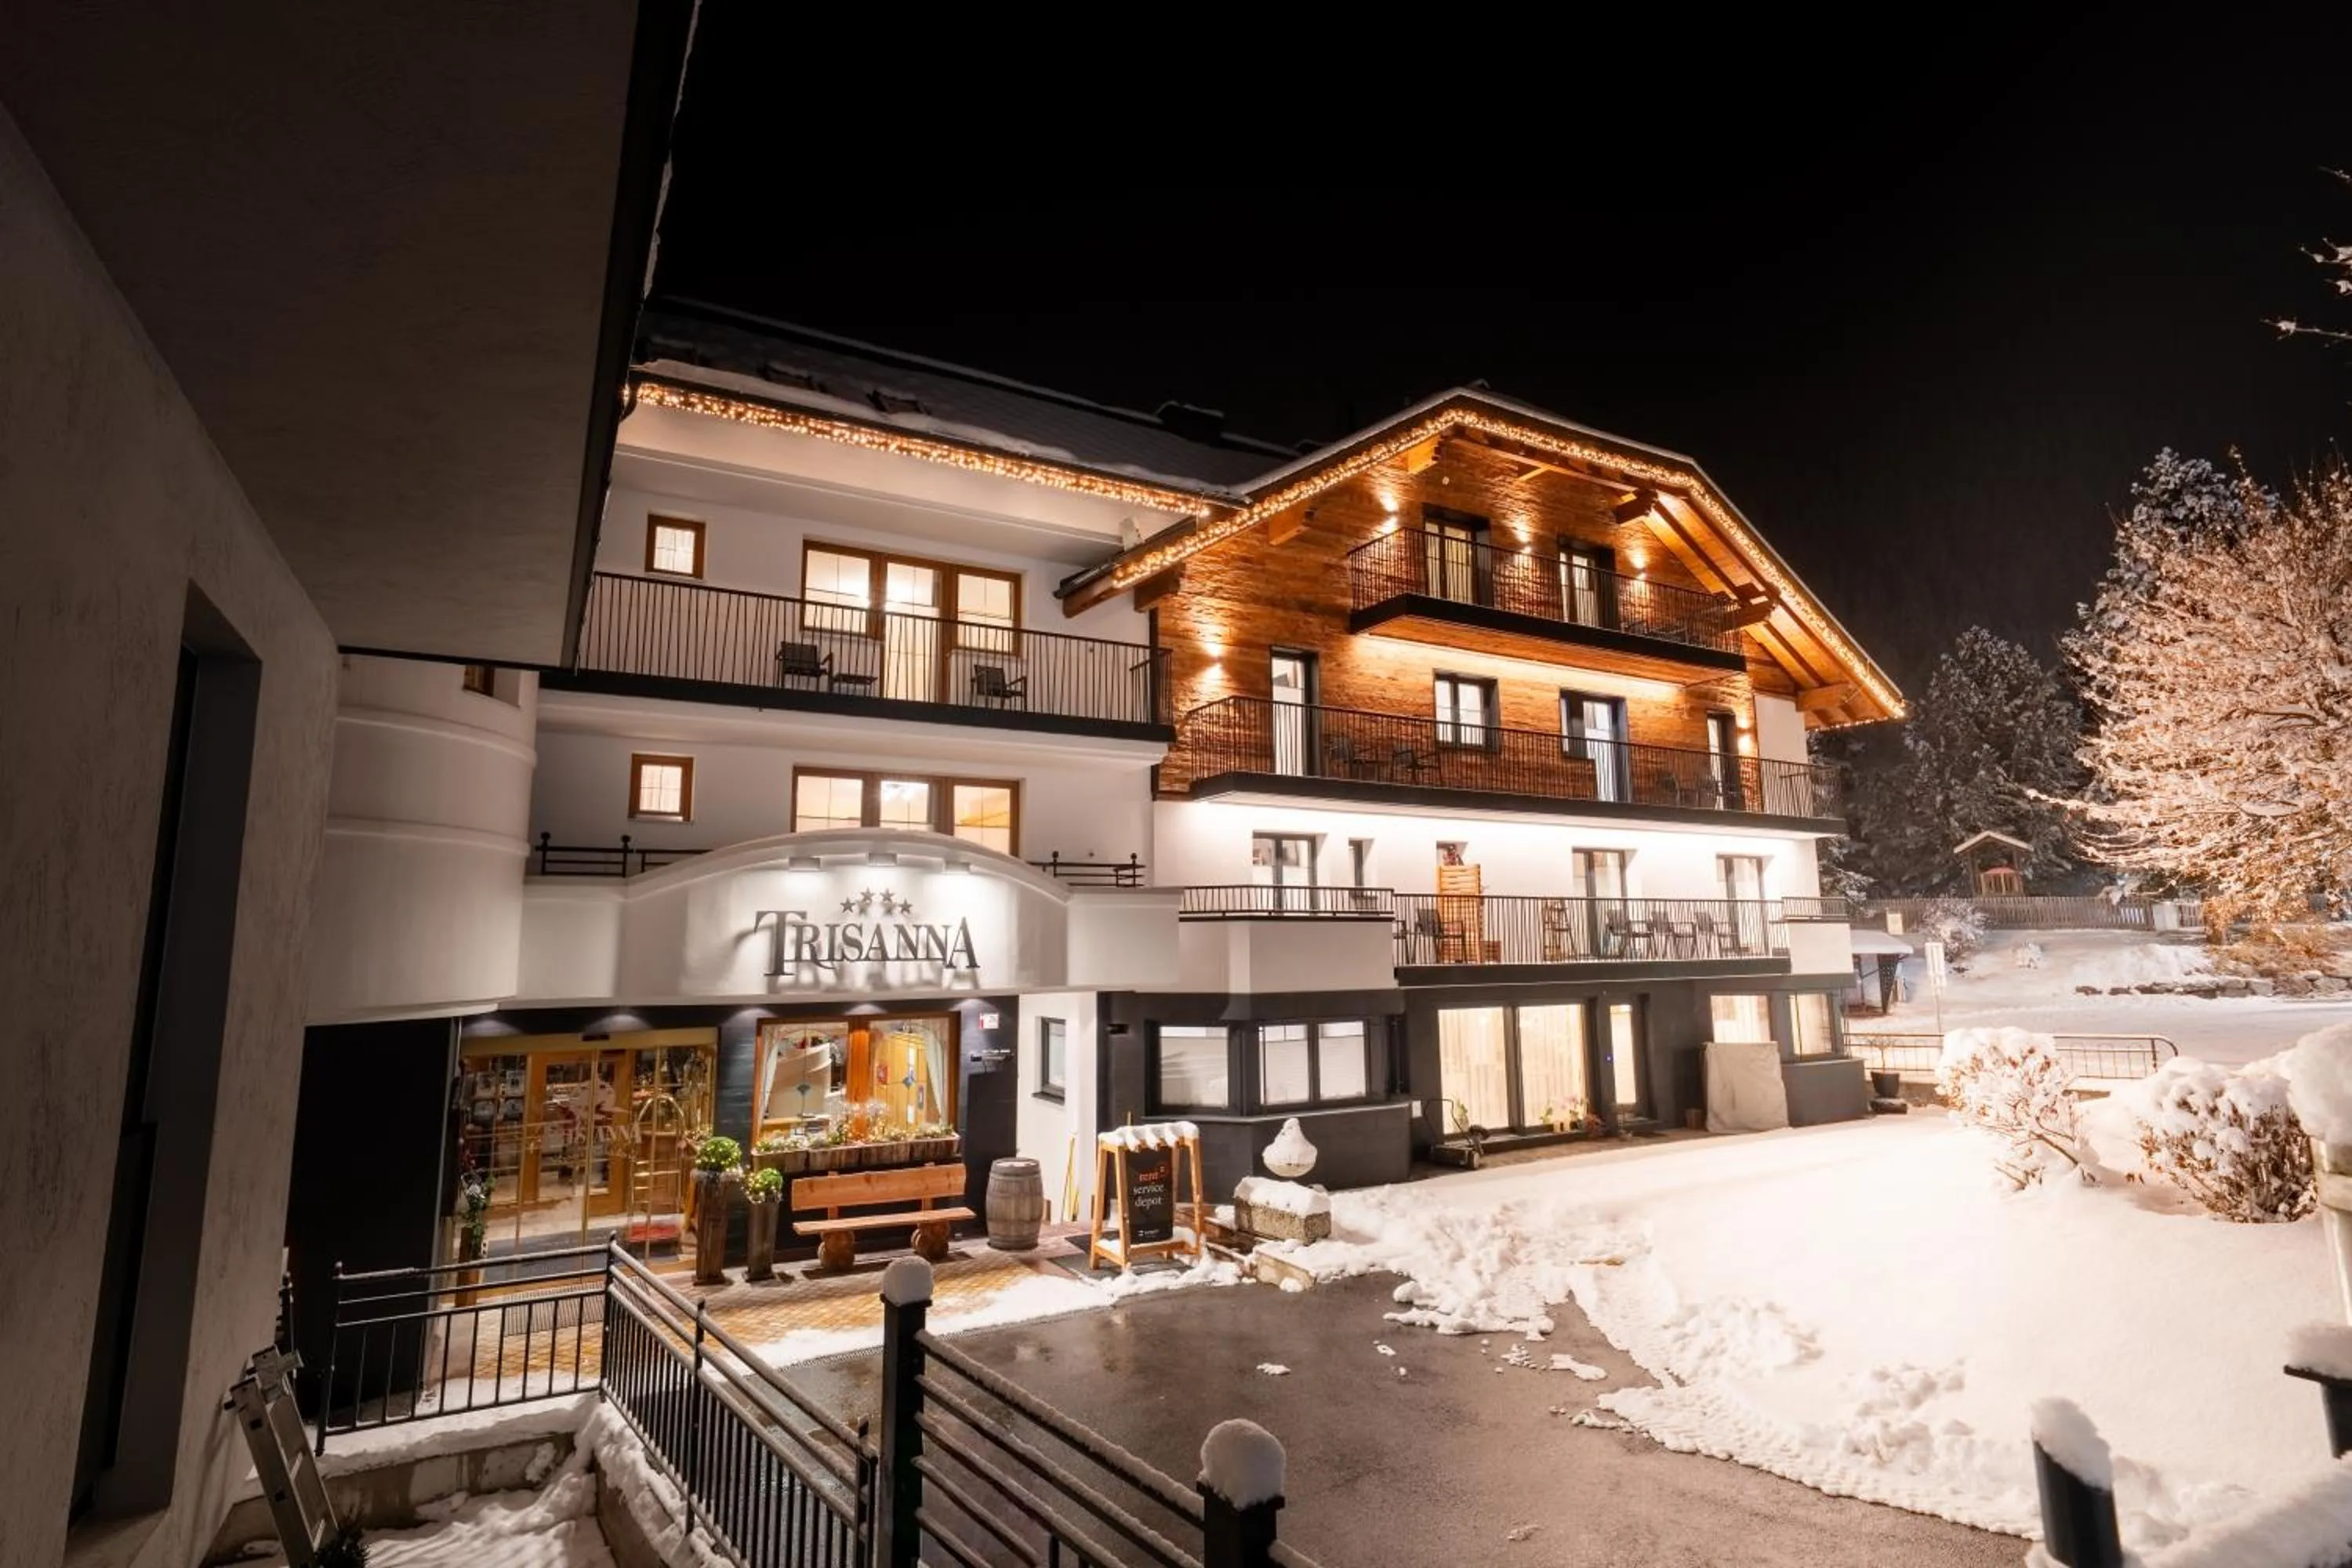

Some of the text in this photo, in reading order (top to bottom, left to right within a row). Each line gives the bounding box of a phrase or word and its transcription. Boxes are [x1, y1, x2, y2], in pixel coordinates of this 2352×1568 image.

[755, 910, 980, 975] TRISANNA
[1133, 1183, 1163, 1194] service
[1135, 1196, 1162, 1209] depot
